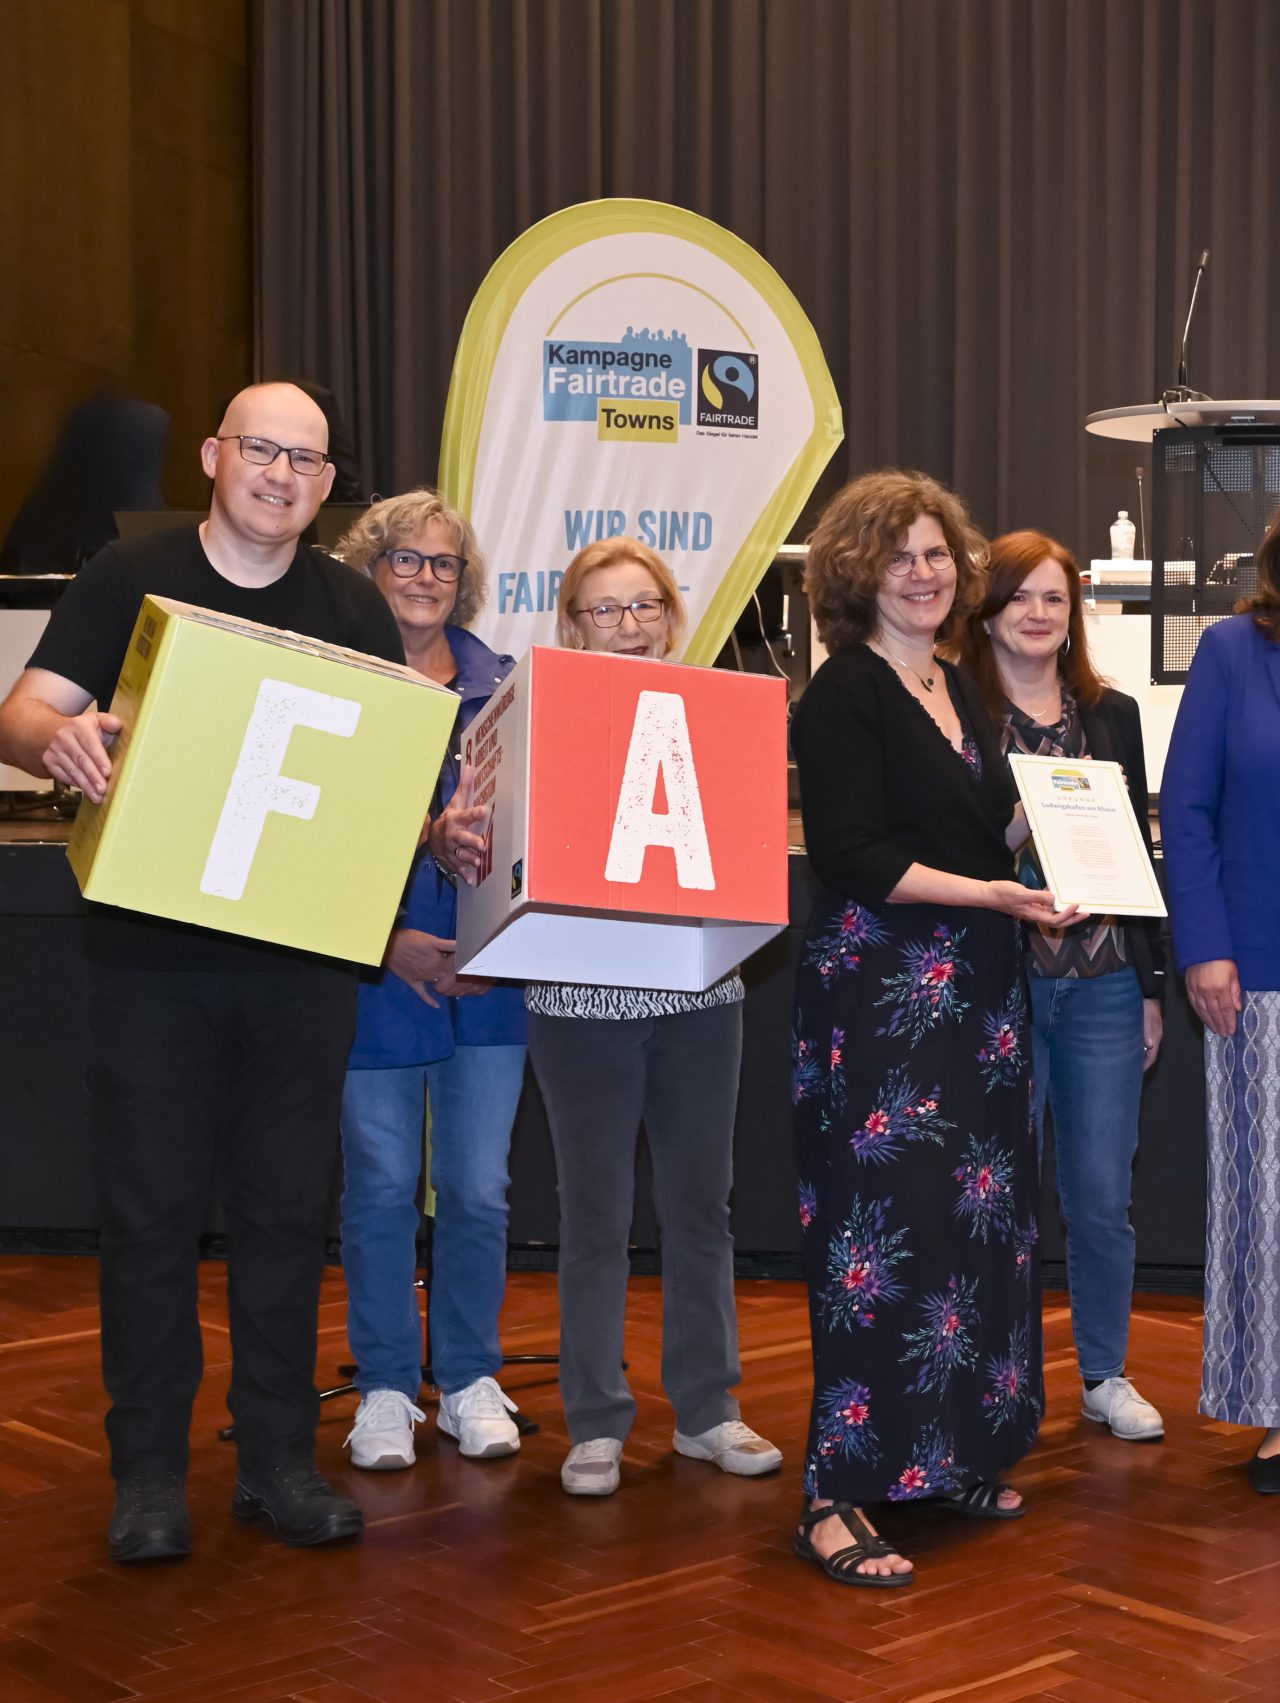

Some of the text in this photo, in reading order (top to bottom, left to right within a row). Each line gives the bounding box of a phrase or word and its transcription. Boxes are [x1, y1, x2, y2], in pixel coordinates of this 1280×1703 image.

[549, 344, 673, 372] Kampagne
[549, 367, 687, 399] Fairtrade
[602, 408, 675, 431] Towns
[700, 412, 755, 426] FAIRTRADE
[564, 510, 713, 551] WIR SIND
[200, 678, 362, 901] F
[604, 690, 716, 891] A
